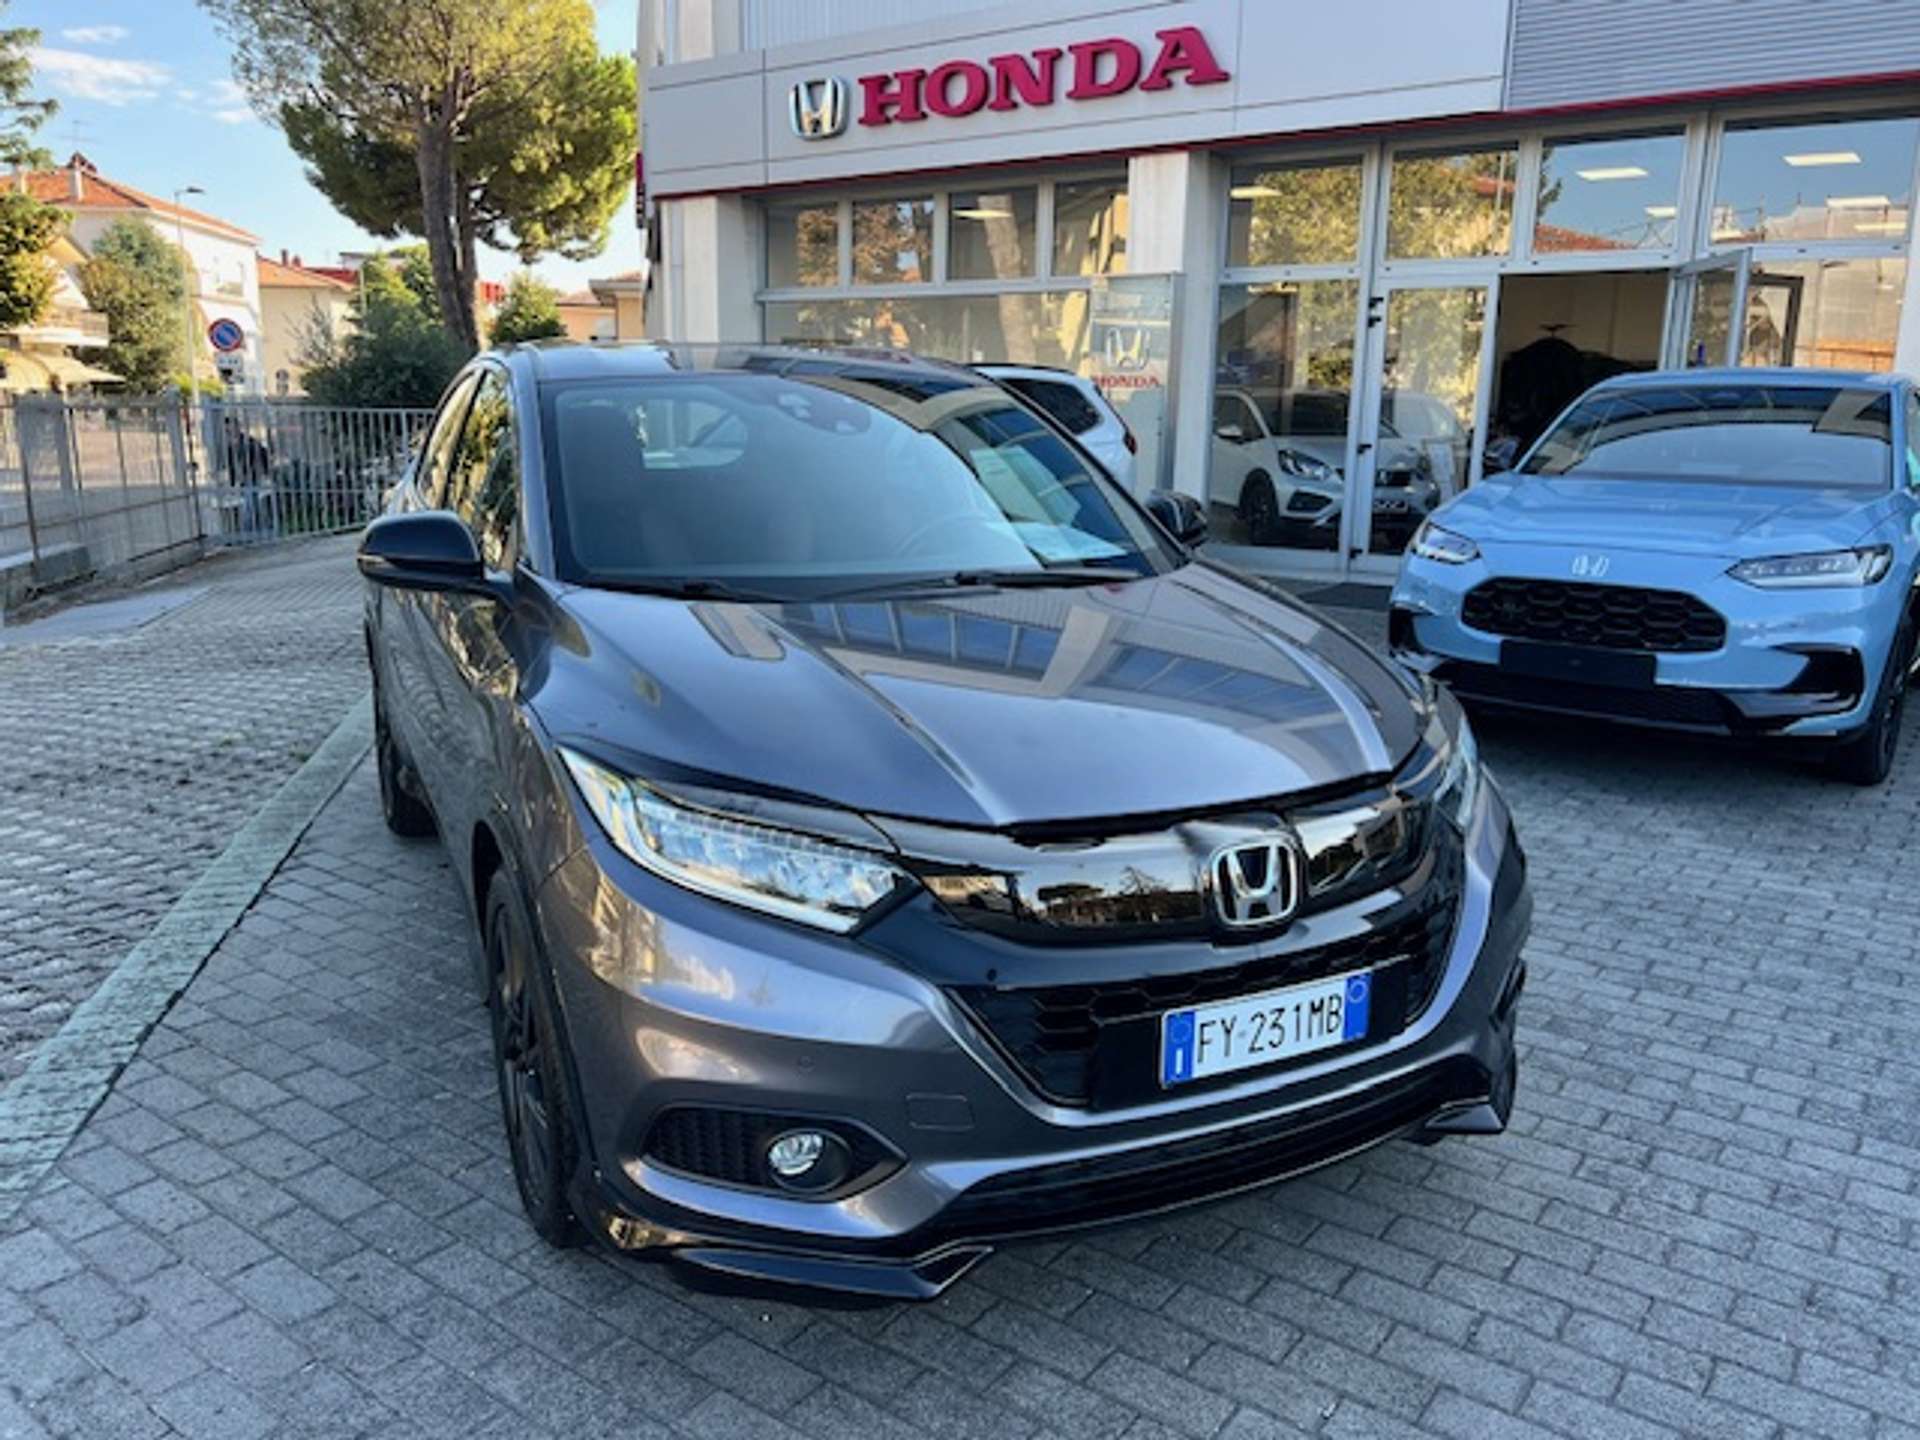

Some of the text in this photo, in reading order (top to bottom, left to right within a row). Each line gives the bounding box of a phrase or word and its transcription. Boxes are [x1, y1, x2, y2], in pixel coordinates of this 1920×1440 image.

[857, 26, 1230, 127] HONDA
[1197, 1014, 1237, 1064] FY
[1248, 992, 1343, 1054] 231MB
